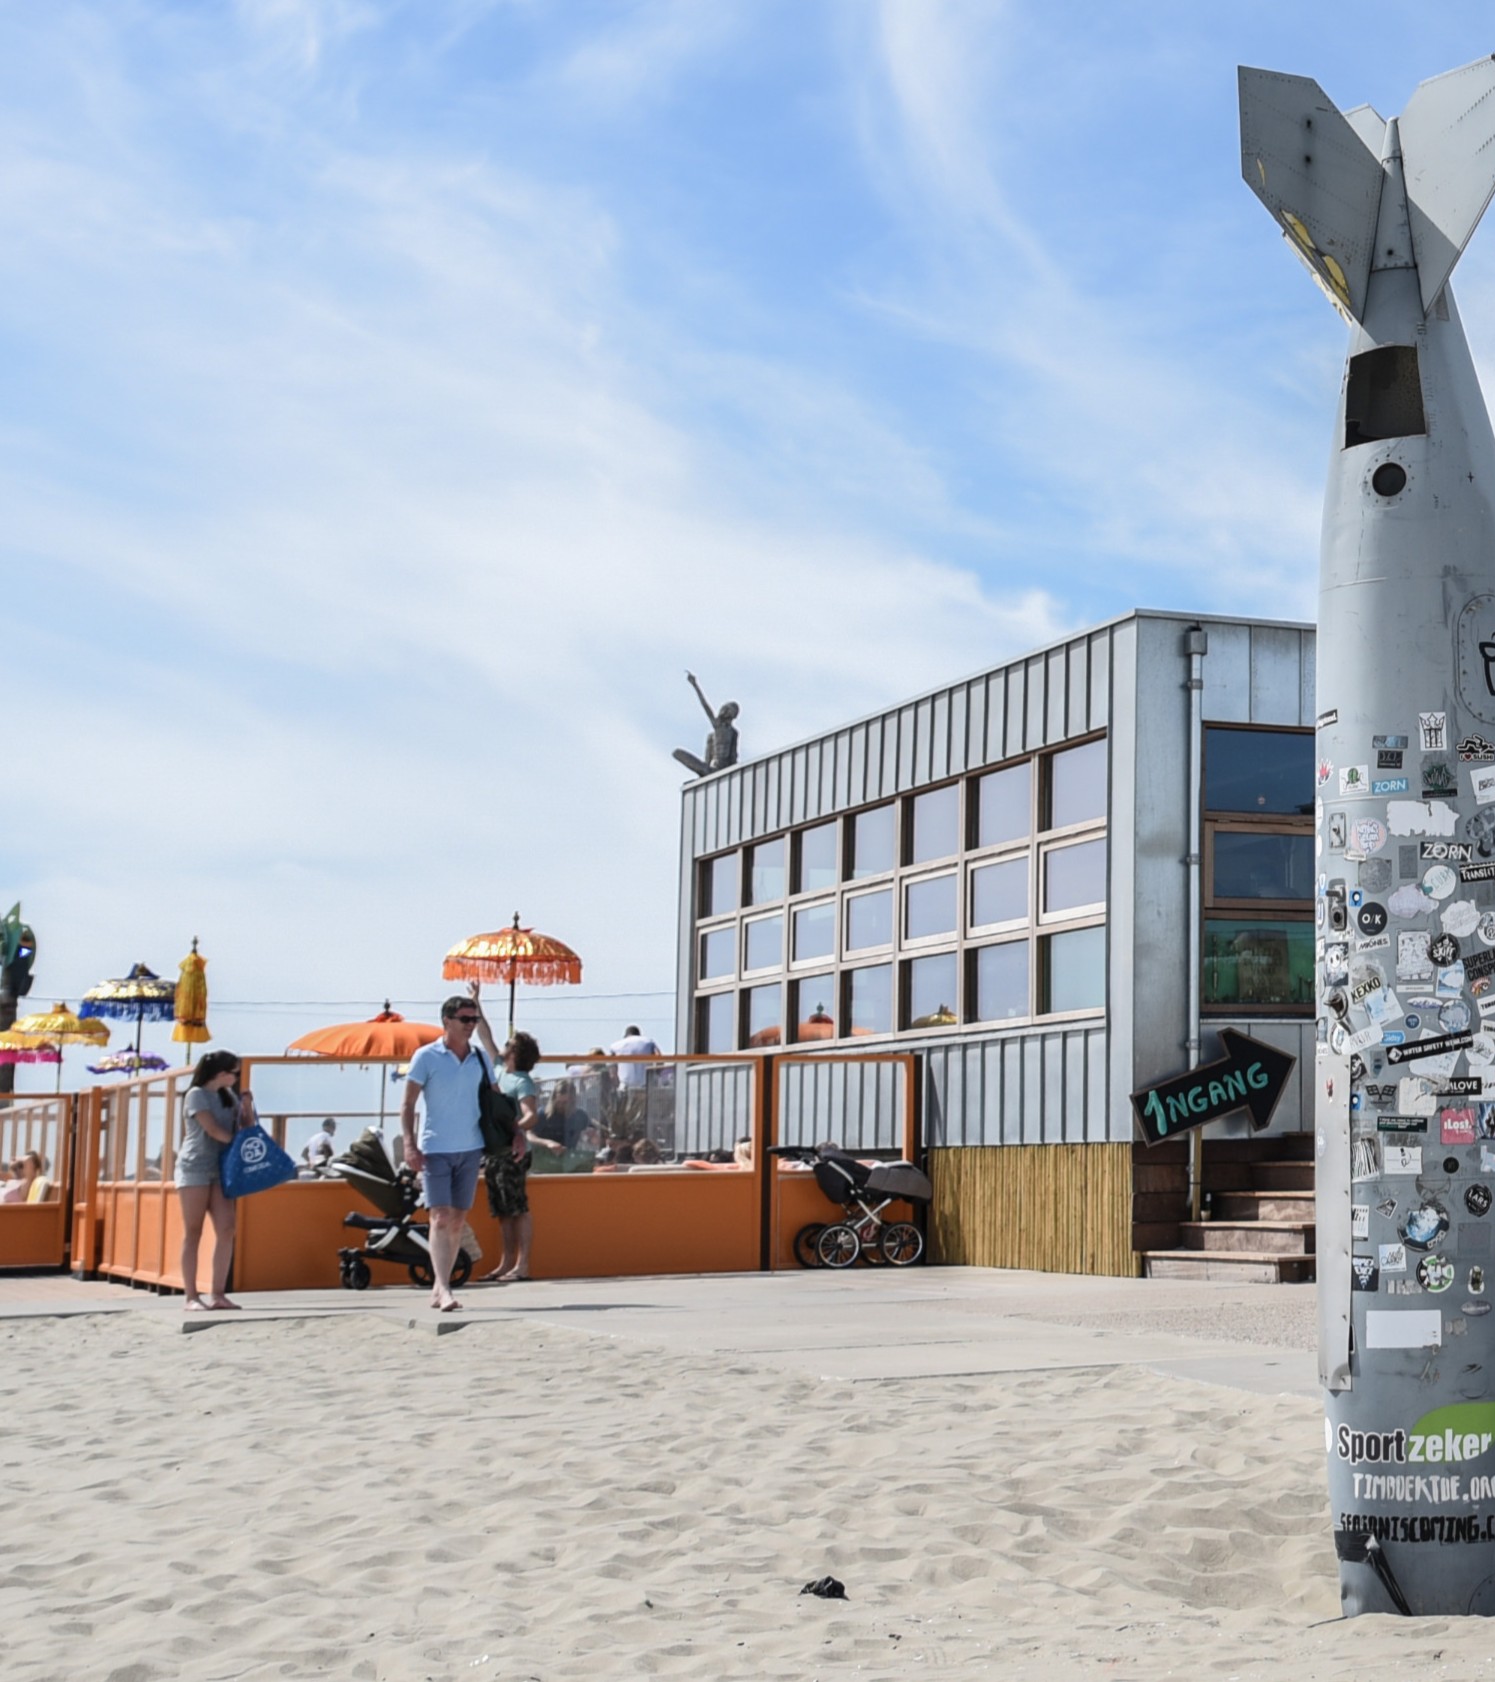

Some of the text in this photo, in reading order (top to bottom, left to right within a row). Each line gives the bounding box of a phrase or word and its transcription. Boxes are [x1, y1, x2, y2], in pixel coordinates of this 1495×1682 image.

[1374, 779, 1406, 793] ZORN
[1422, 841, 1472, 862] ZORN
[1350, 977, 1381, 1001] KEXKO
[1144, 1062, 1269, 1136] INGANG
